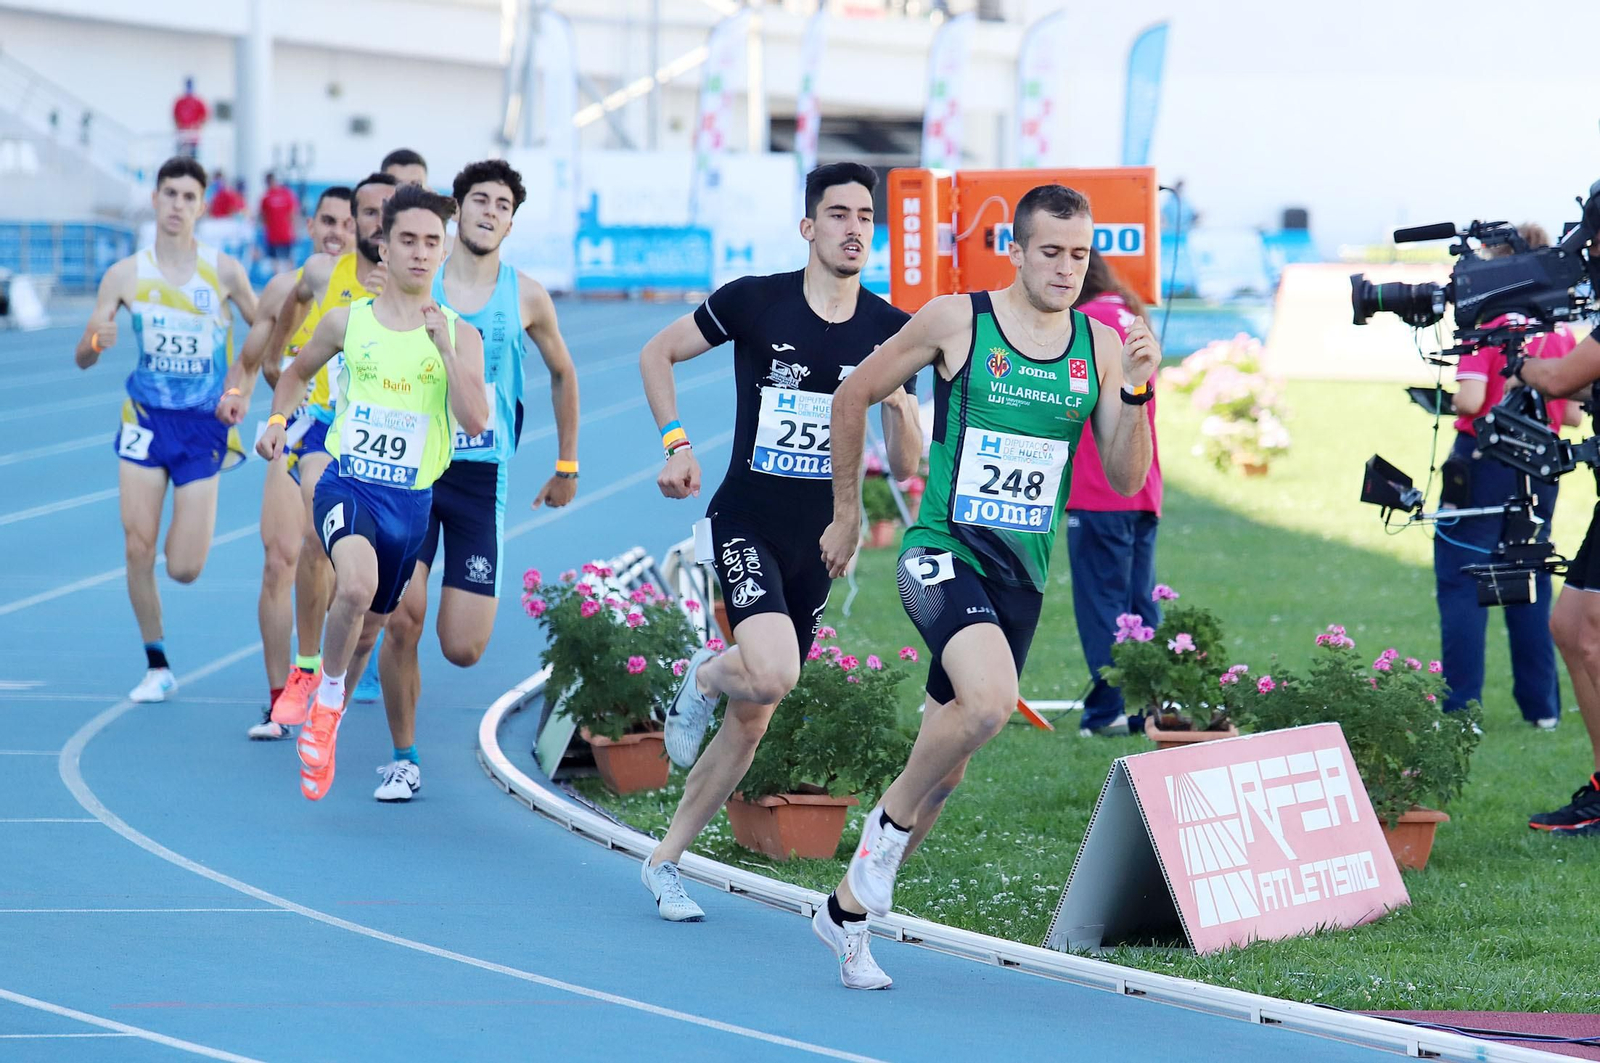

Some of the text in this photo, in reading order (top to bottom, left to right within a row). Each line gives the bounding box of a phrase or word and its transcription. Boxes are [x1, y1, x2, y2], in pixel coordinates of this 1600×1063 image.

[903, 197, 922, 285] MONDO
[155, 333, 198, 356] 253
[799, 395, 831, 405] DIPUTAC
[990, 380, 1063, 405] VILLARREAL
[812, 404, 831, 413] HUE
[126, 430, 141, 453] 2
[352, 429, 407, 461] 249
[776, 420, 831, 451] 252
[1003, 447, 1055, 460] DE HUELVA
[979, 464, 1045, 501] 248
[1257, 850, 1380, 912] ATLETISMO
